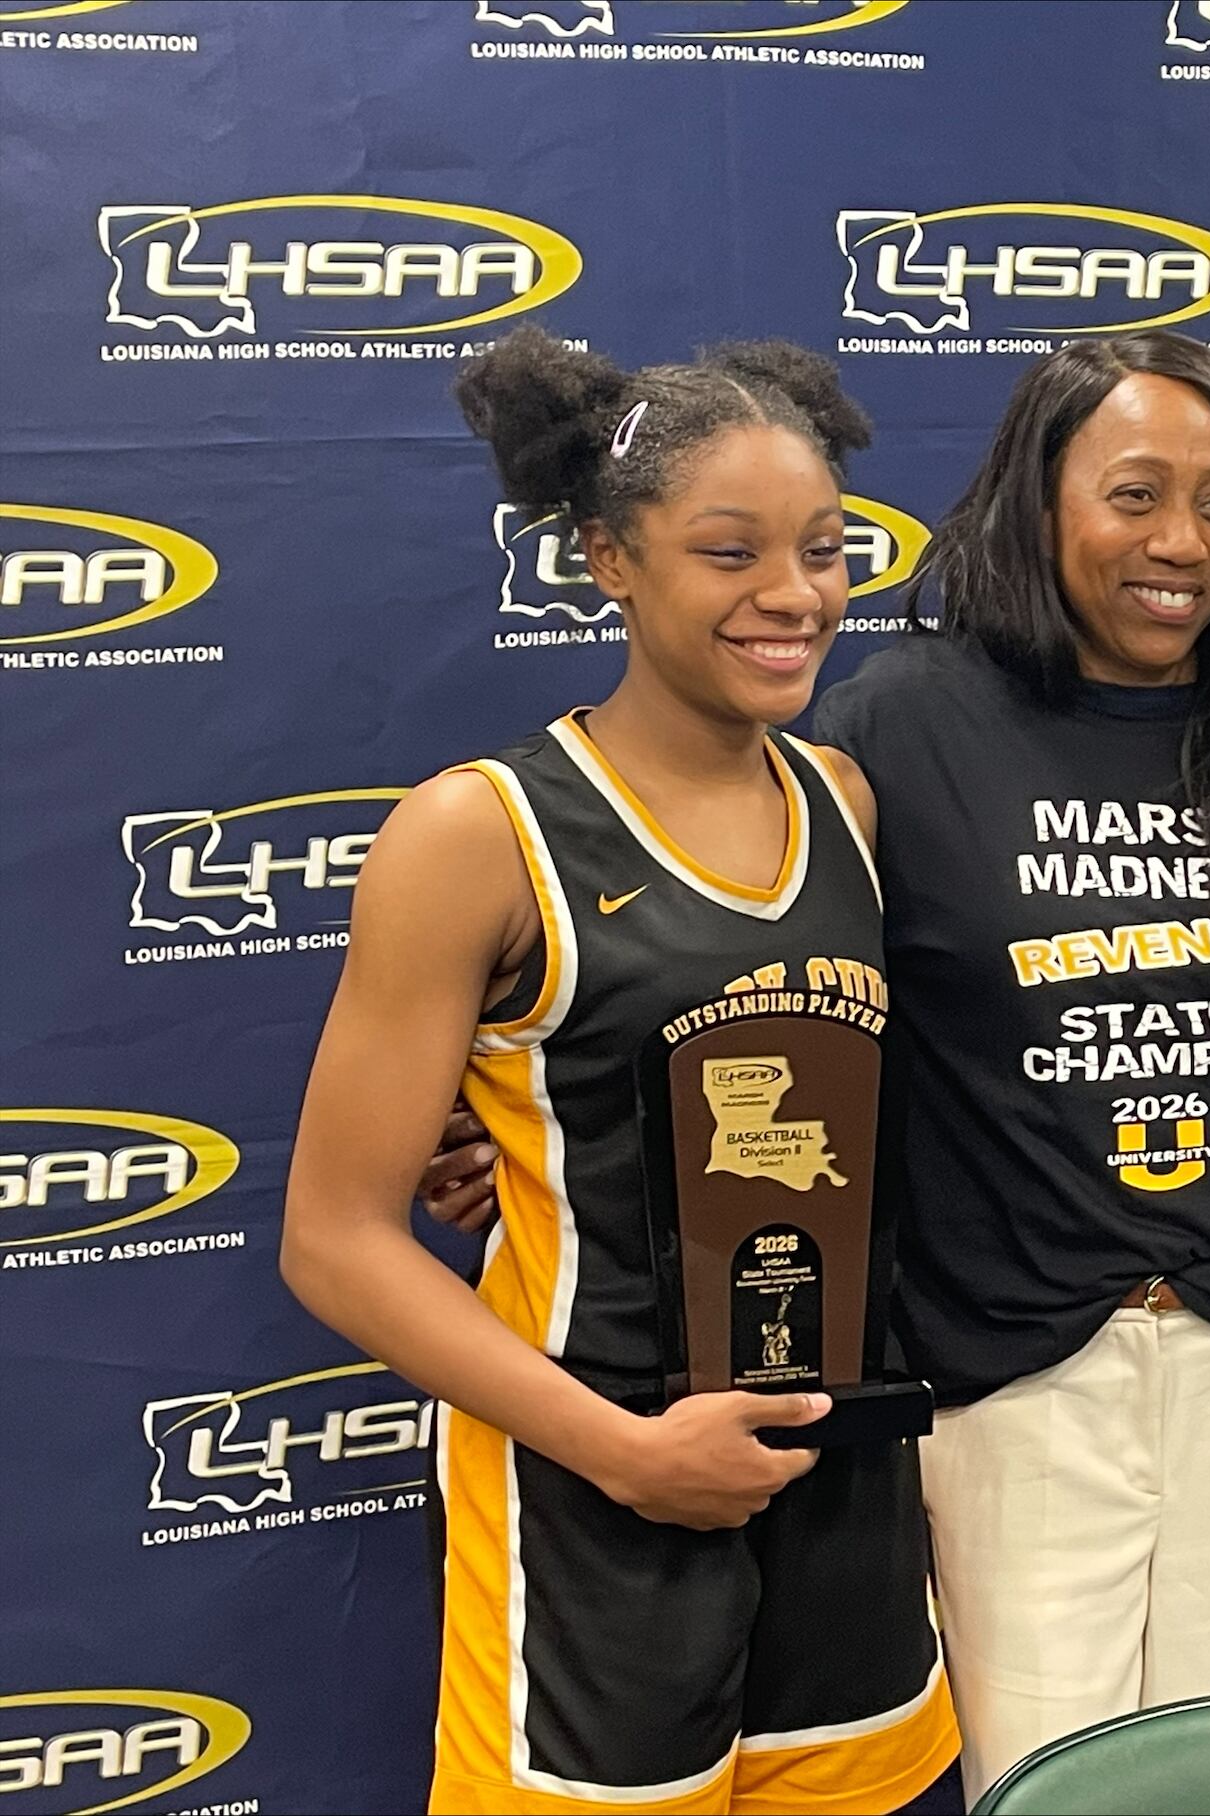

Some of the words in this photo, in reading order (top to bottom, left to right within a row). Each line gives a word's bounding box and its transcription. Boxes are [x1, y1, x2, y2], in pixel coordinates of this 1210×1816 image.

[0, 31, 51, 49] ETIC
[56, 33, 198, 52] ASSOCIATION
[471, 42, 575, 59] LOUISIANA
[579, 44, 627, 60] HIGH
[632, 45, 707, 61] SCHOOL
[711, 45, 800, 64] ATHLETIC
[803, 49, 925, 70] ASSOCIATION
[146, 241, 535, 297] LHSAA
[101, 344, 212, 362] LOUISIANA
[217, 343, 269, 360] HIGH
[274, 342, 356, 359] SCHOOL
[361, 341, 456, 359] ATHLETIC
[838, 338, 933, 355] LOUISIANA
[938, 339, 982, 355] HIGH
[985, 340, 1054, 356] SCHOOL
[0, 651, 79, 669] HLETIC
[85, 646, 223, 668] ASSOCIATION
[169, 834, 378, 898] LHS
[125, 941, 235, 965] LOUISIANA
[240, 936, 291, 956] HIGH
[296, 931, 350, 950] SCHO
[662, 992, 804, 1044] OUTSTANDING
[807, 993, 887, 1036] PLAYER
[1111, 1093, 1209, 1124] 2026
[726, 1129, 814, 1145] BASKETBALL
[740, 1146, 791, 1158] Division
[2, 1248, 104, 1269] ATHLETIC
[108, 1232, 245, 1261] ASSOCIATION
[754, 1234, 799, 1254] 2026
[188, 1399, 434, 1478] LHS
[142, 1518, 251, 1546] LOUISIANA
[255, 1508, 305, 1531] HIGH
[310, 1499, 389, 1522] SCHOOL
